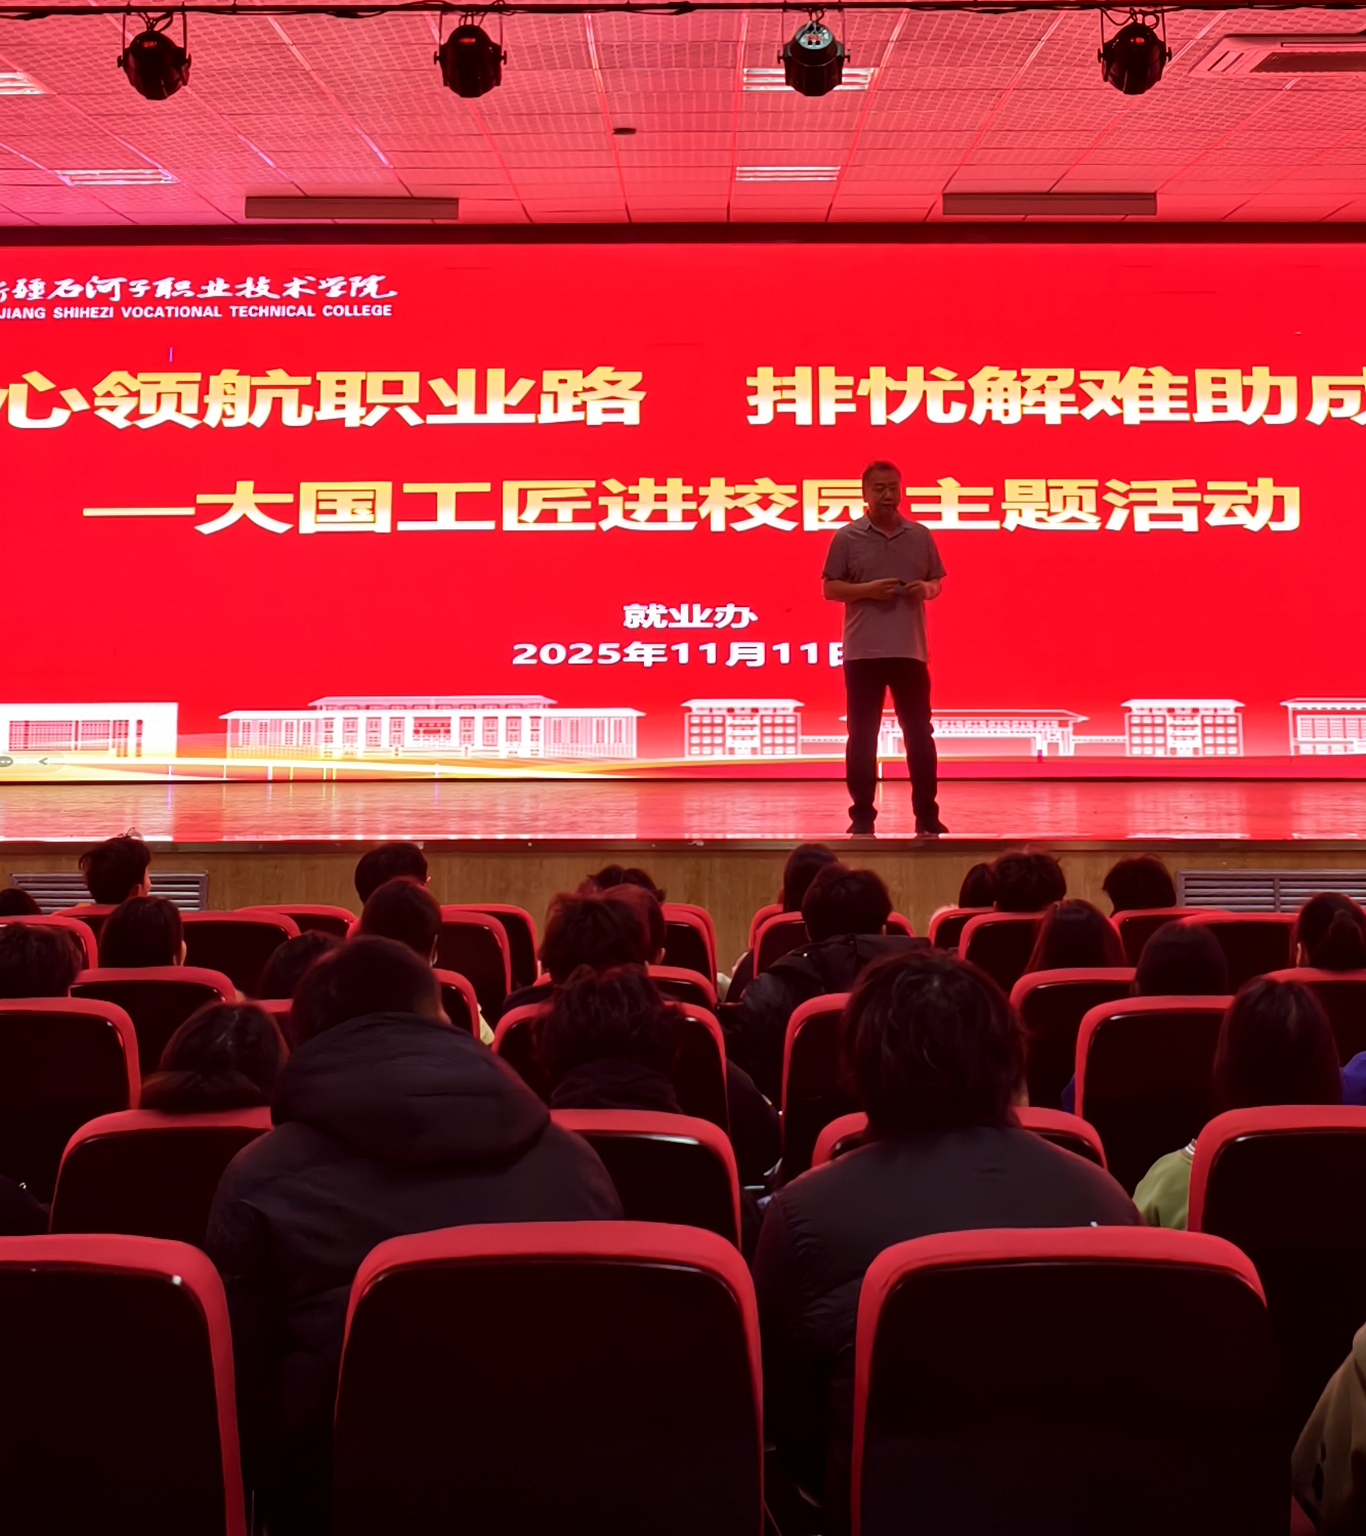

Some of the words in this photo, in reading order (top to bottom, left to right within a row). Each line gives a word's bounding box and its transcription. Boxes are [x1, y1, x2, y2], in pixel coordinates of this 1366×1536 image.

[53, 307, 113, 319] SHIHEZI
[121, 306, 222, 318] VOCATIONAL
[230, 305, 316, 317] TECHNICAL
[323, 305, 392, 317] COLLEGE
[623, 603, 758, 628] 就业办
